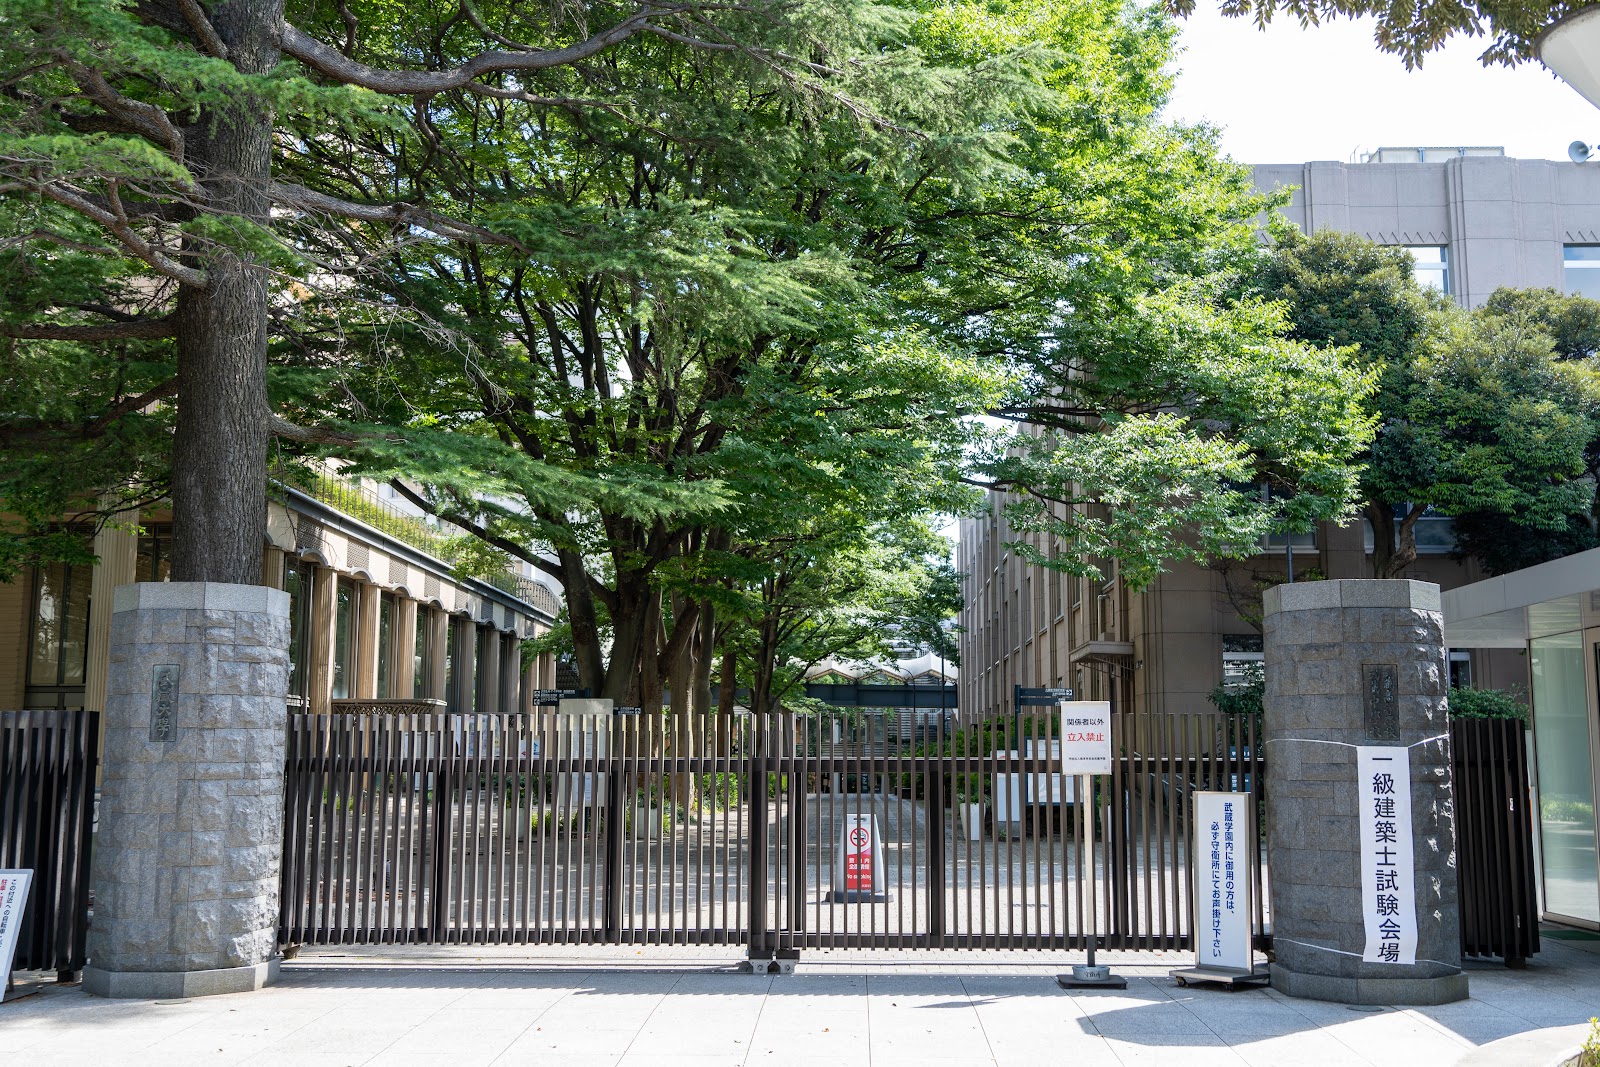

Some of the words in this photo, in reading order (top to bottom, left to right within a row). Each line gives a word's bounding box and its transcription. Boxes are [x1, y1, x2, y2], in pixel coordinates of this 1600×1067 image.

[1066, 718, 1104, 726] 関係者以外
[1067, 732, 1105, 742] 立入禁止
[1210, 821, 1222, 958] 必ず守衛所にてお声掛け下さい
[1224, 802, 1235, 915] 武蔵学園内に御用の方は、
[1371, 757, 1401, 963] 一級建築士試験会場
